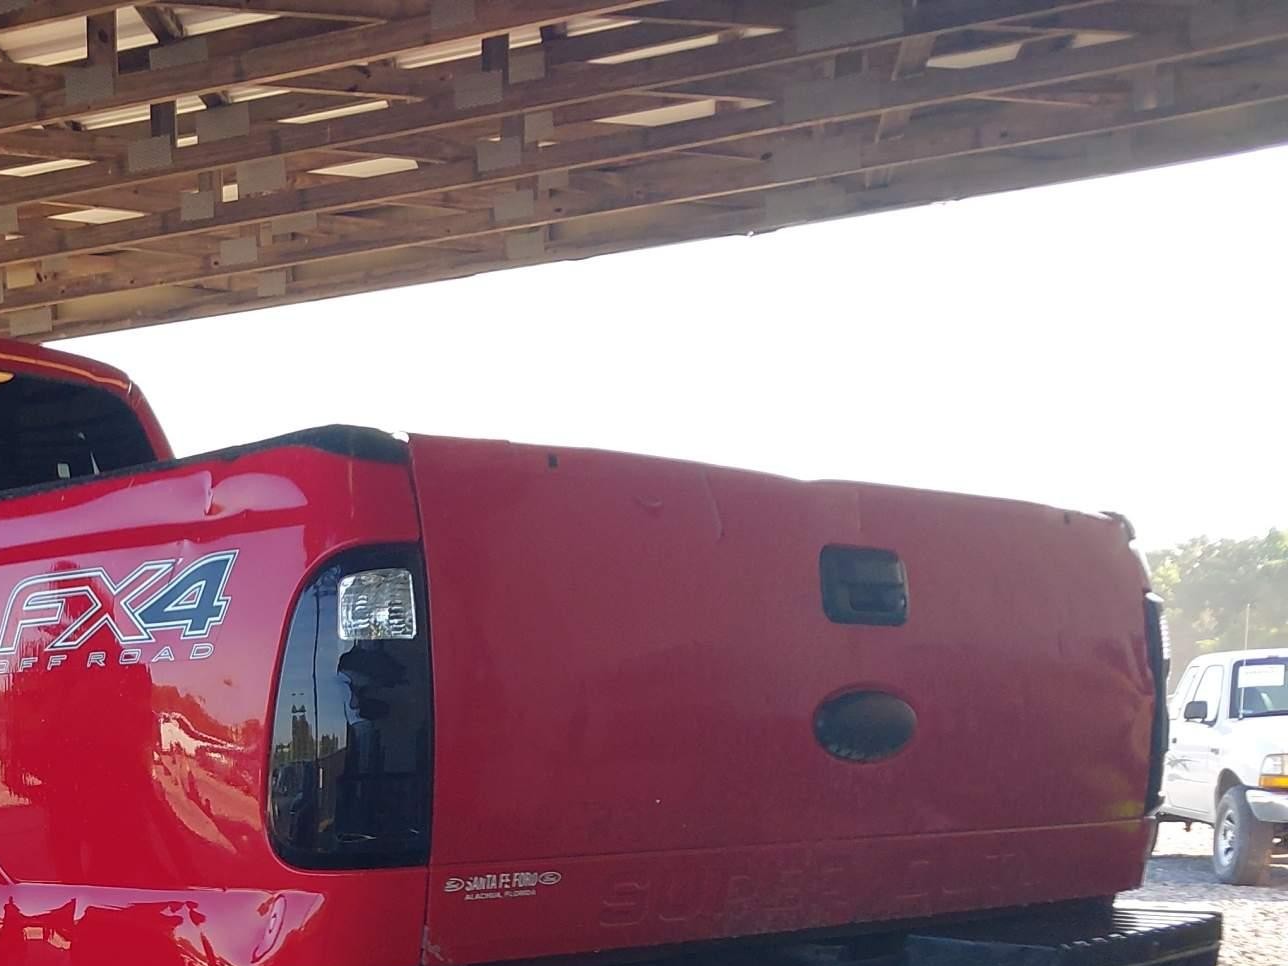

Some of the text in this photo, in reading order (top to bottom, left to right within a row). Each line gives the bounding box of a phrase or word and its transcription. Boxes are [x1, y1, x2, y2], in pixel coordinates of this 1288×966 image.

[86, 643, 216, 668] ROAD
[464, 874, 497, 891] SANTA
[499, 873, 511, 888] FE
[512, 872, 538, 888] FORD
